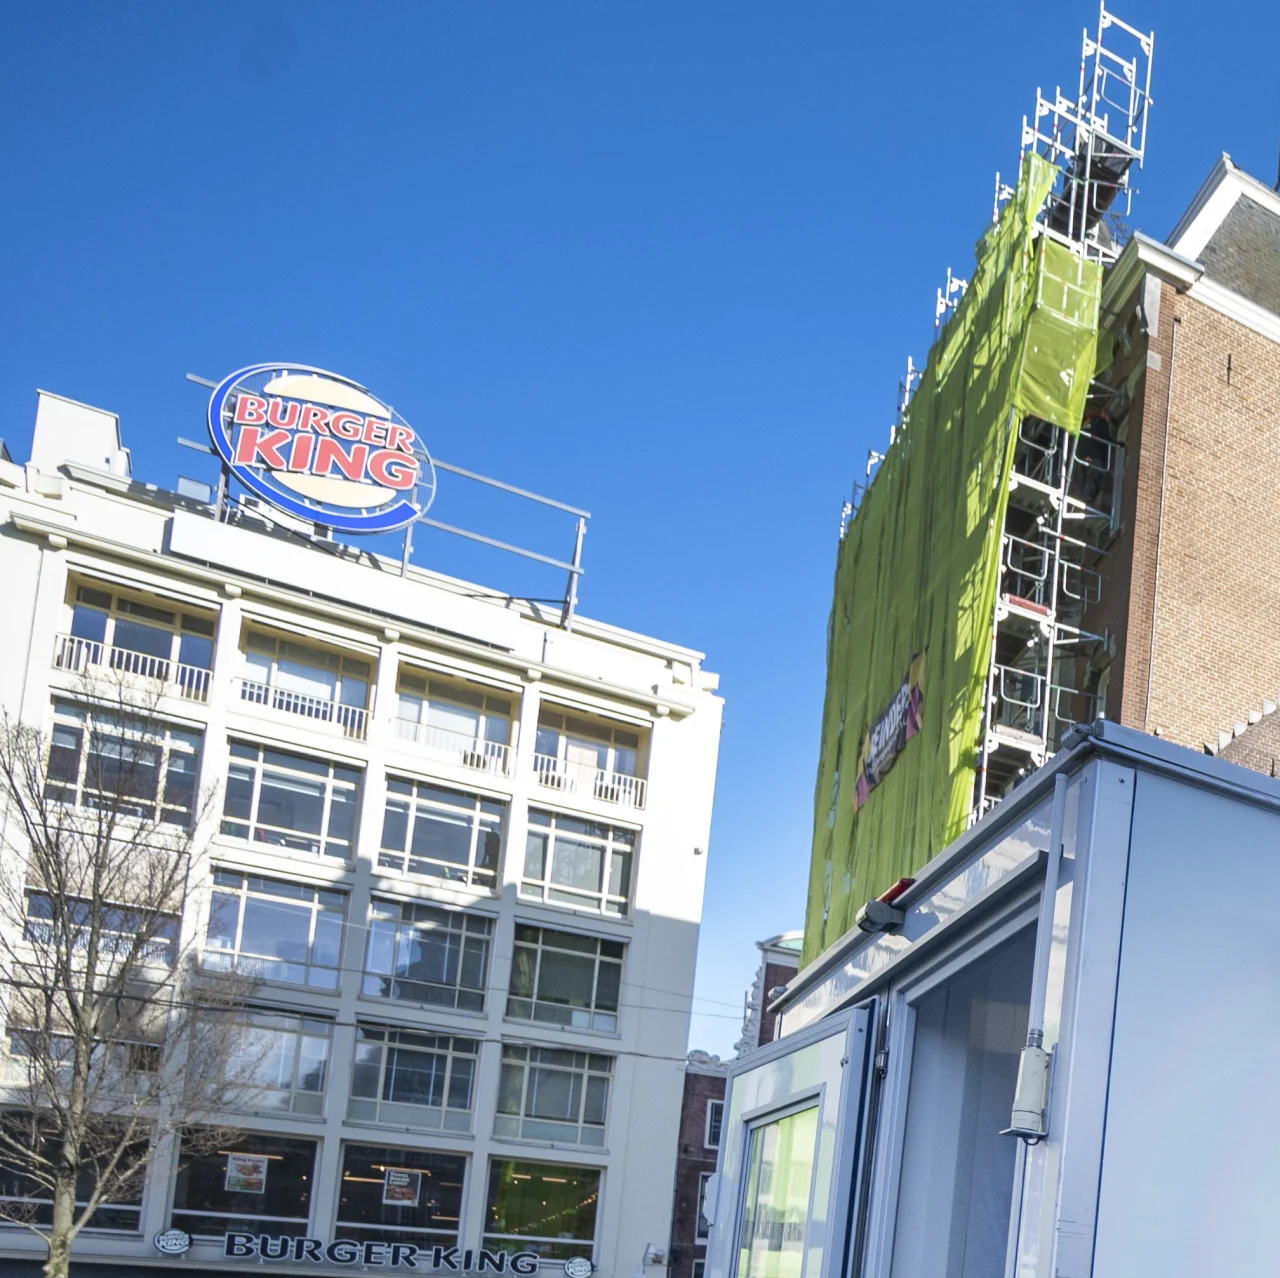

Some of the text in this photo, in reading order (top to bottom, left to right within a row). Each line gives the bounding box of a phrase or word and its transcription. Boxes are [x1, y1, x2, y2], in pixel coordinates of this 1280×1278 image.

[233, 394, 415, 454] BURGER
[232, 425, 419, 490] KING
[225, 1231, 539, 1275] BURGER KING
